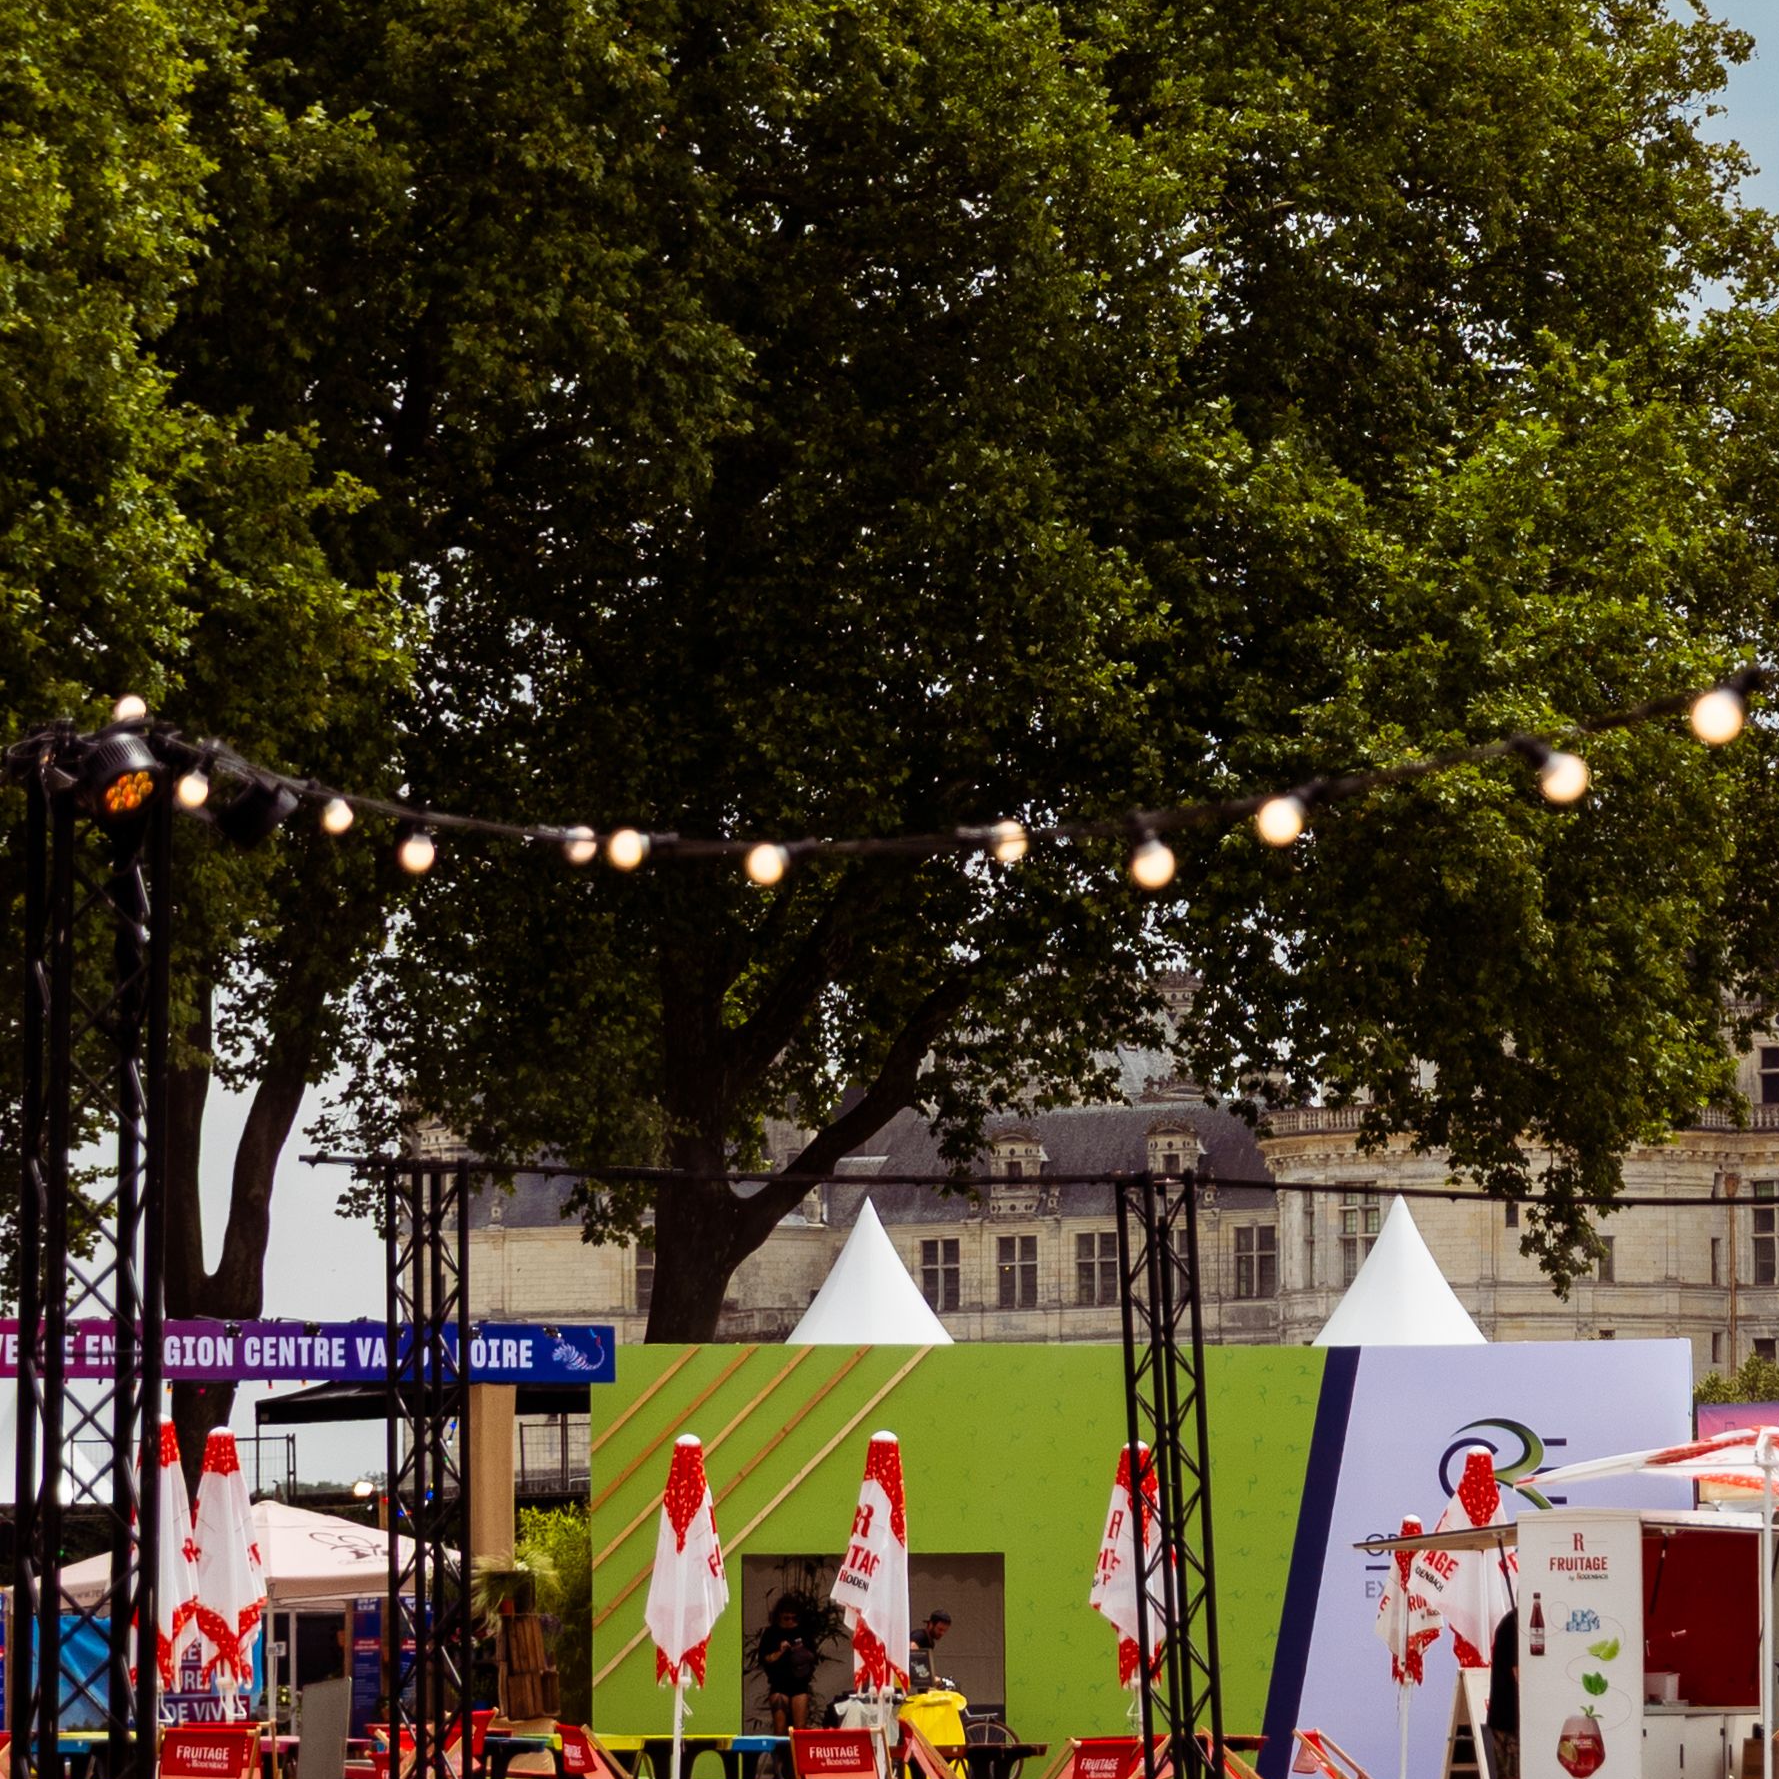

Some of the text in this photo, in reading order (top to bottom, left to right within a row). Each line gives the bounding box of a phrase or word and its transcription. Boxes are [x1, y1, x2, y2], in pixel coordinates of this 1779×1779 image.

[244, 1336, 346, 1367] CENTRE
[1573, 1533, 1584, 1551] R
[1550, 1556, 1608, 1571] FRUITAGE
[176, 1745, 229, 1761] FRUITAGE
[809, 1745, 860, 1759] FRUITAGE
[1080, 1757, 1119, 1770] FRUITAGE
